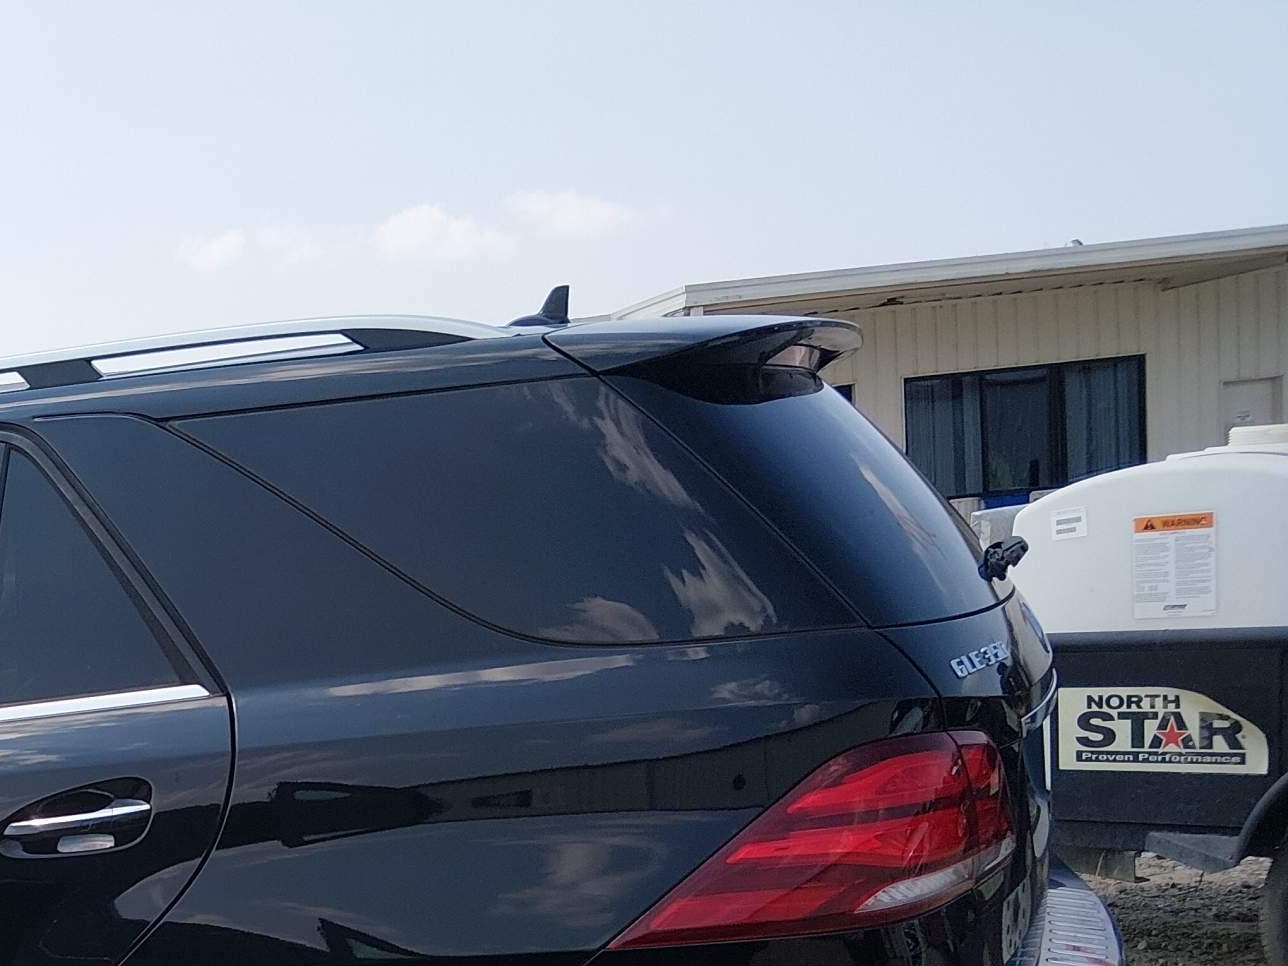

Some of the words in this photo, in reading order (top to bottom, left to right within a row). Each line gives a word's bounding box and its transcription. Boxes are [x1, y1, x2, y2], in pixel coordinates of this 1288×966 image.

[1086, 694, 1181, 710] NORTH
[1075, 710, 1246, 751] STAR
[1081, 751, 1134, 762] Proven
[1138, 752, 1242, 764] Performance
